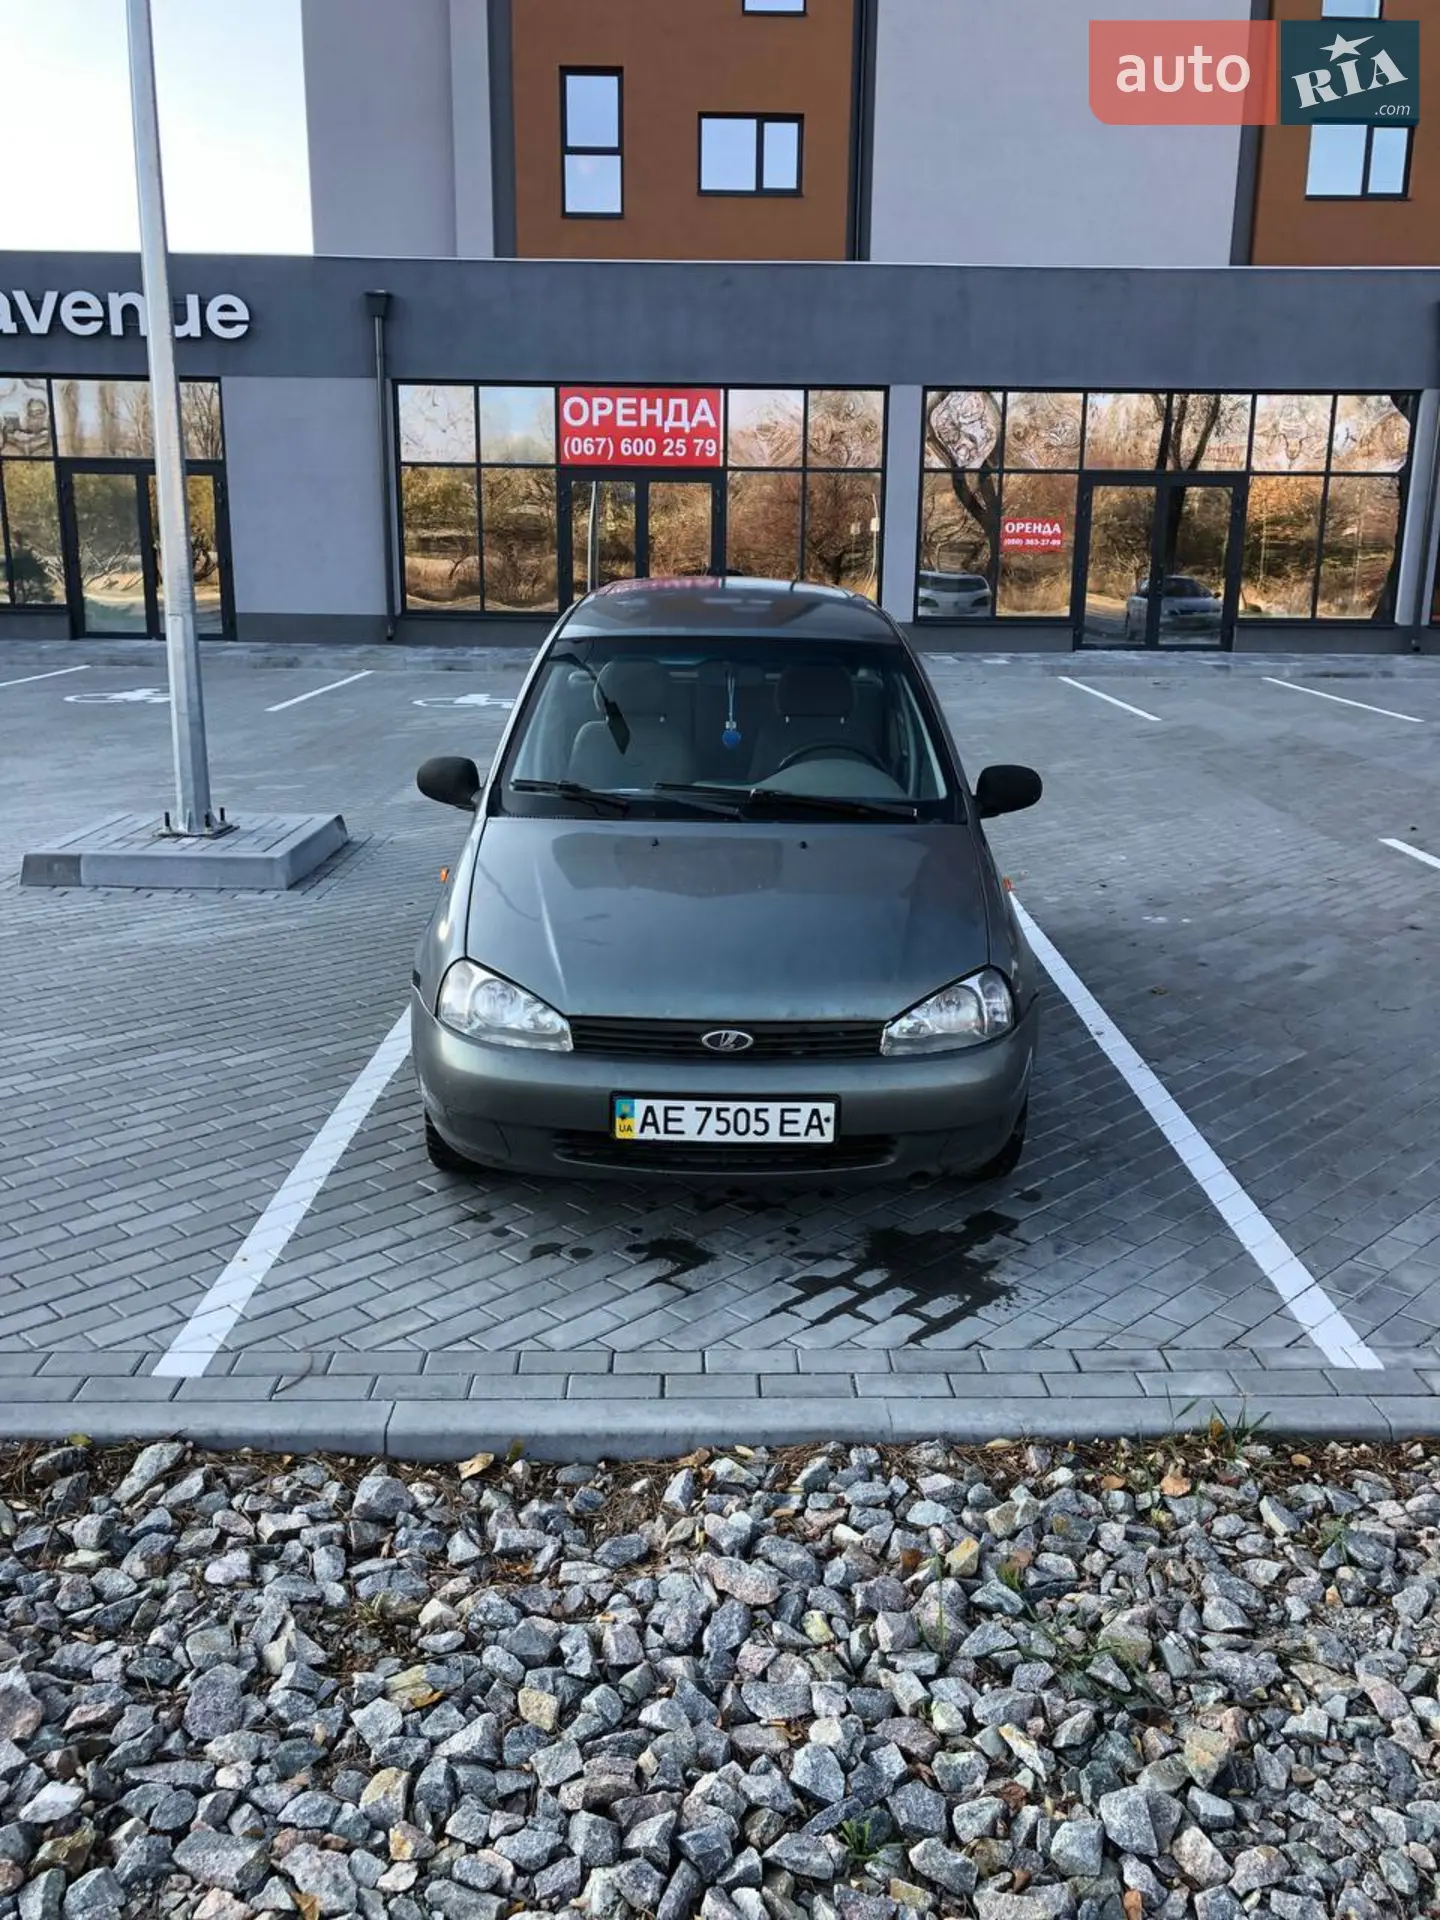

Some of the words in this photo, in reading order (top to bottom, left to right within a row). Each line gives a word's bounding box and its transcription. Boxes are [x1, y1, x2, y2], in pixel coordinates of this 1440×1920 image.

[563, 396, 717, 434] ОРЕНДА
[563, 436, 614, 461] (067)
[620, 438, 656, 456] 600
[663, 439, 687, 457] 25
[693, 439, 717, 457] 79
[1005, 521, 1062, 536] ОРЕНДА
[619, 1124, 633, 1133] UA
[639, 1105, 685, 1135] AE
[695, 1107, 769, 1136] 7505
[779, 1108, 826, 1137] EA
